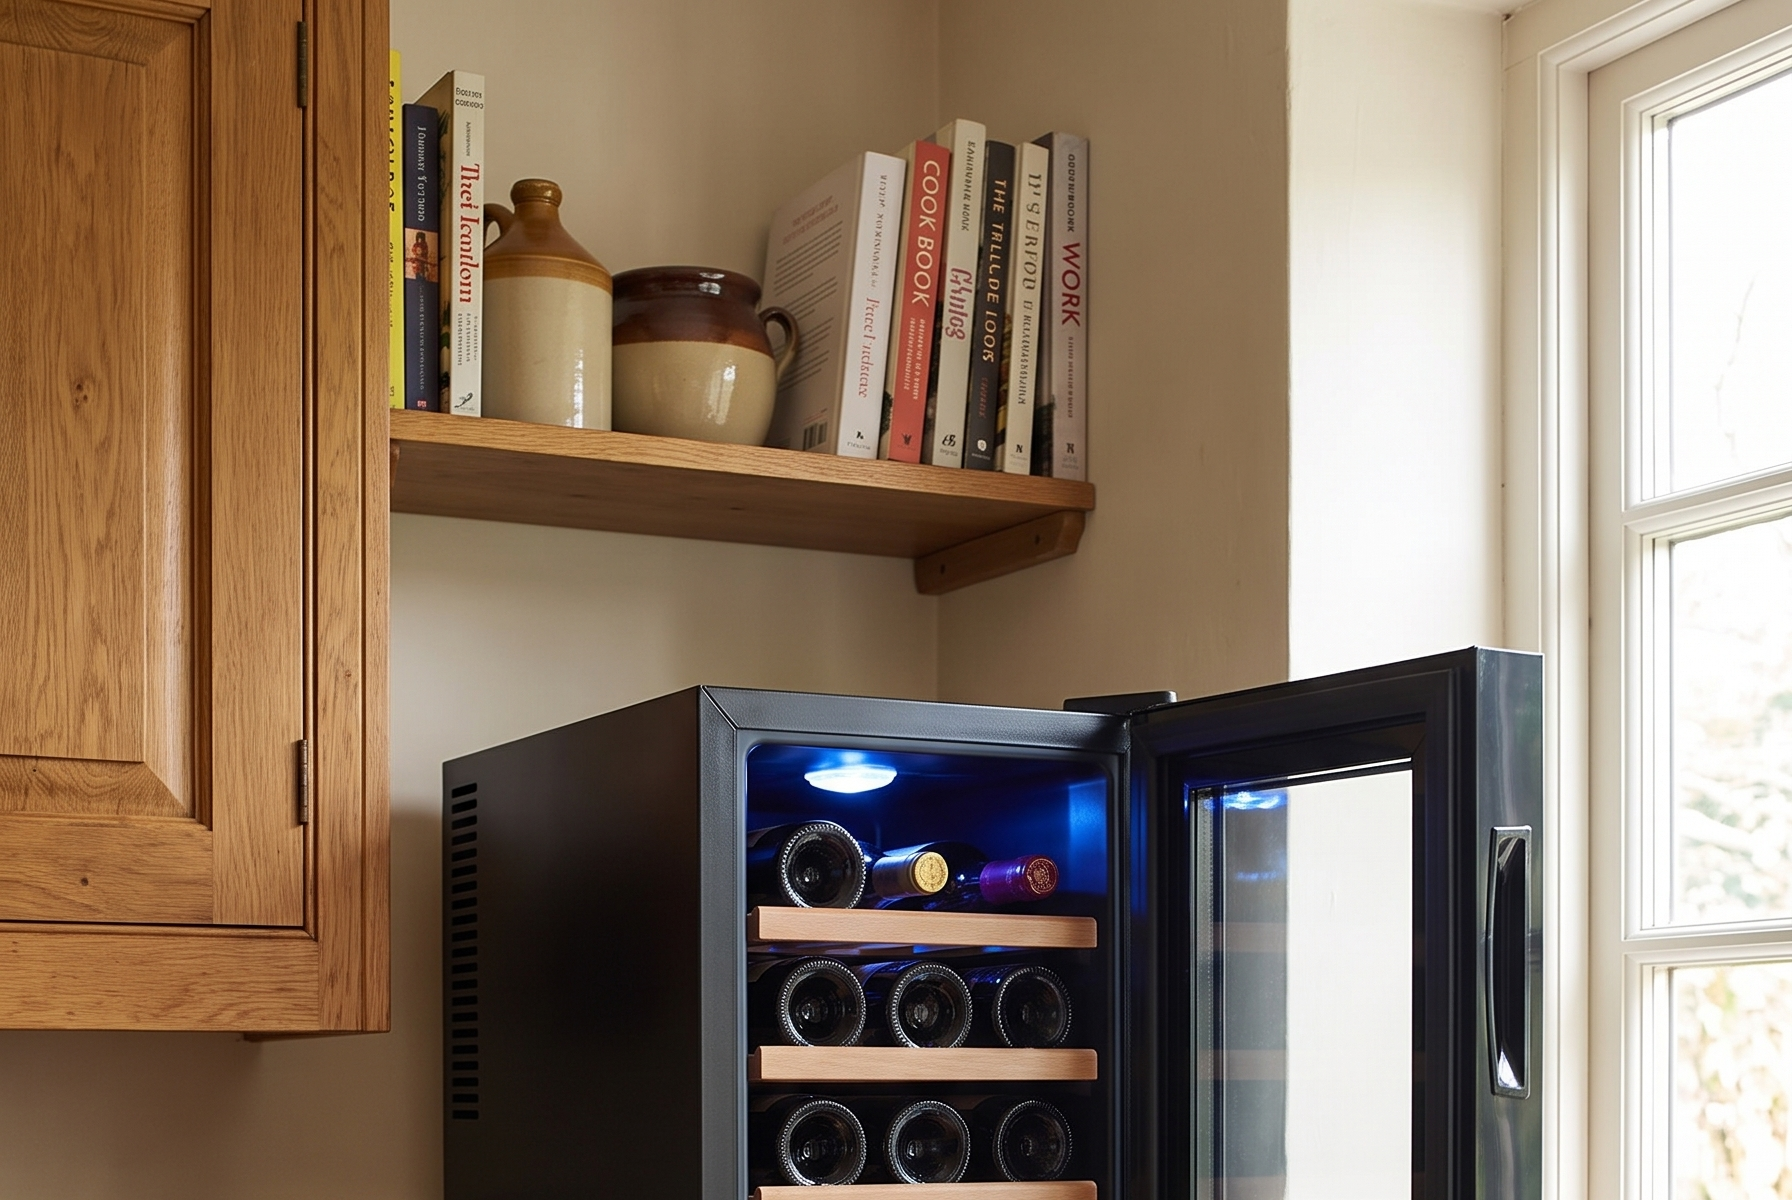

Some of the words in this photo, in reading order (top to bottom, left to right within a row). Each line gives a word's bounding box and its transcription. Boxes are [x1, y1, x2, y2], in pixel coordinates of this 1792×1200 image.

[919, 159, 940, 231] COOK
[992, 179, 1007, 215] THE
[912, 236, 934, 308] BOOK
[1061, 241, 1082, 328] WORK
